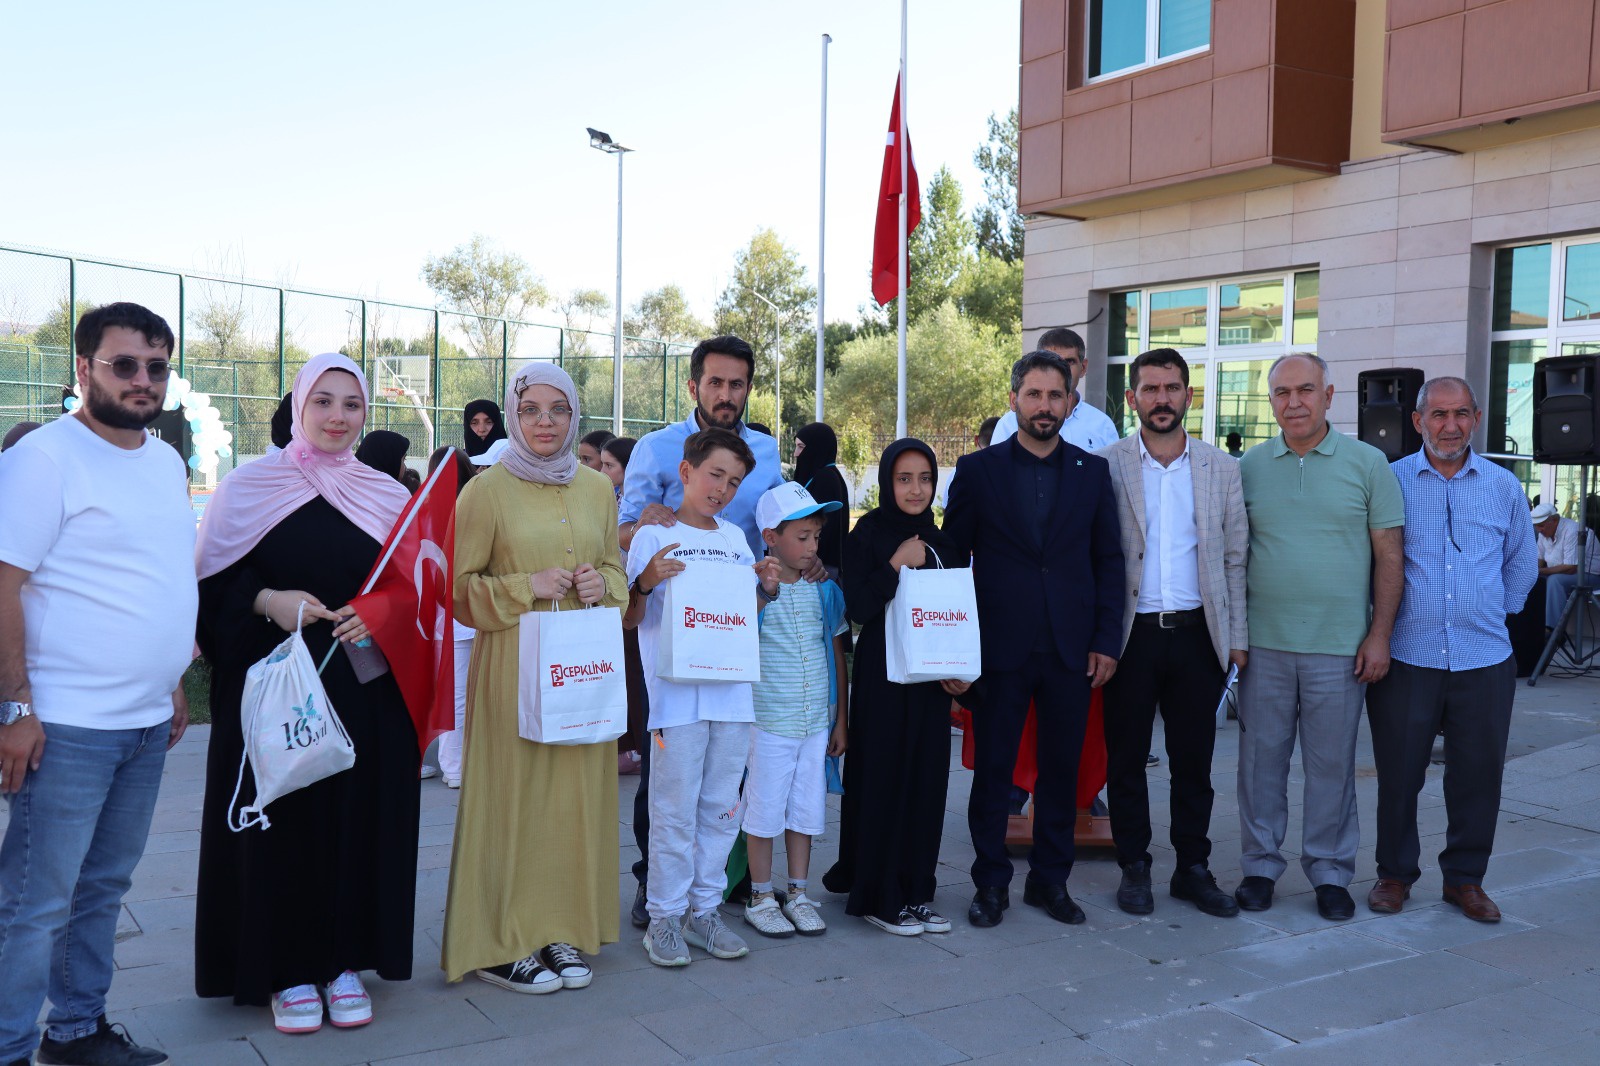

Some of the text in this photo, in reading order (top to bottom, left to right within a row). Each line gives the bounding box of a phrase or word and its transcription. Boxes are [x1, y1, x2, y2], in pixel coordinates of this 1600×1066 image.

[695, 612, 747, 627] CEPKLİNİK
[923, 608, 968, 621] CEPKLİNİK
[563, 660, 614, 677] CEPKLİNİK
